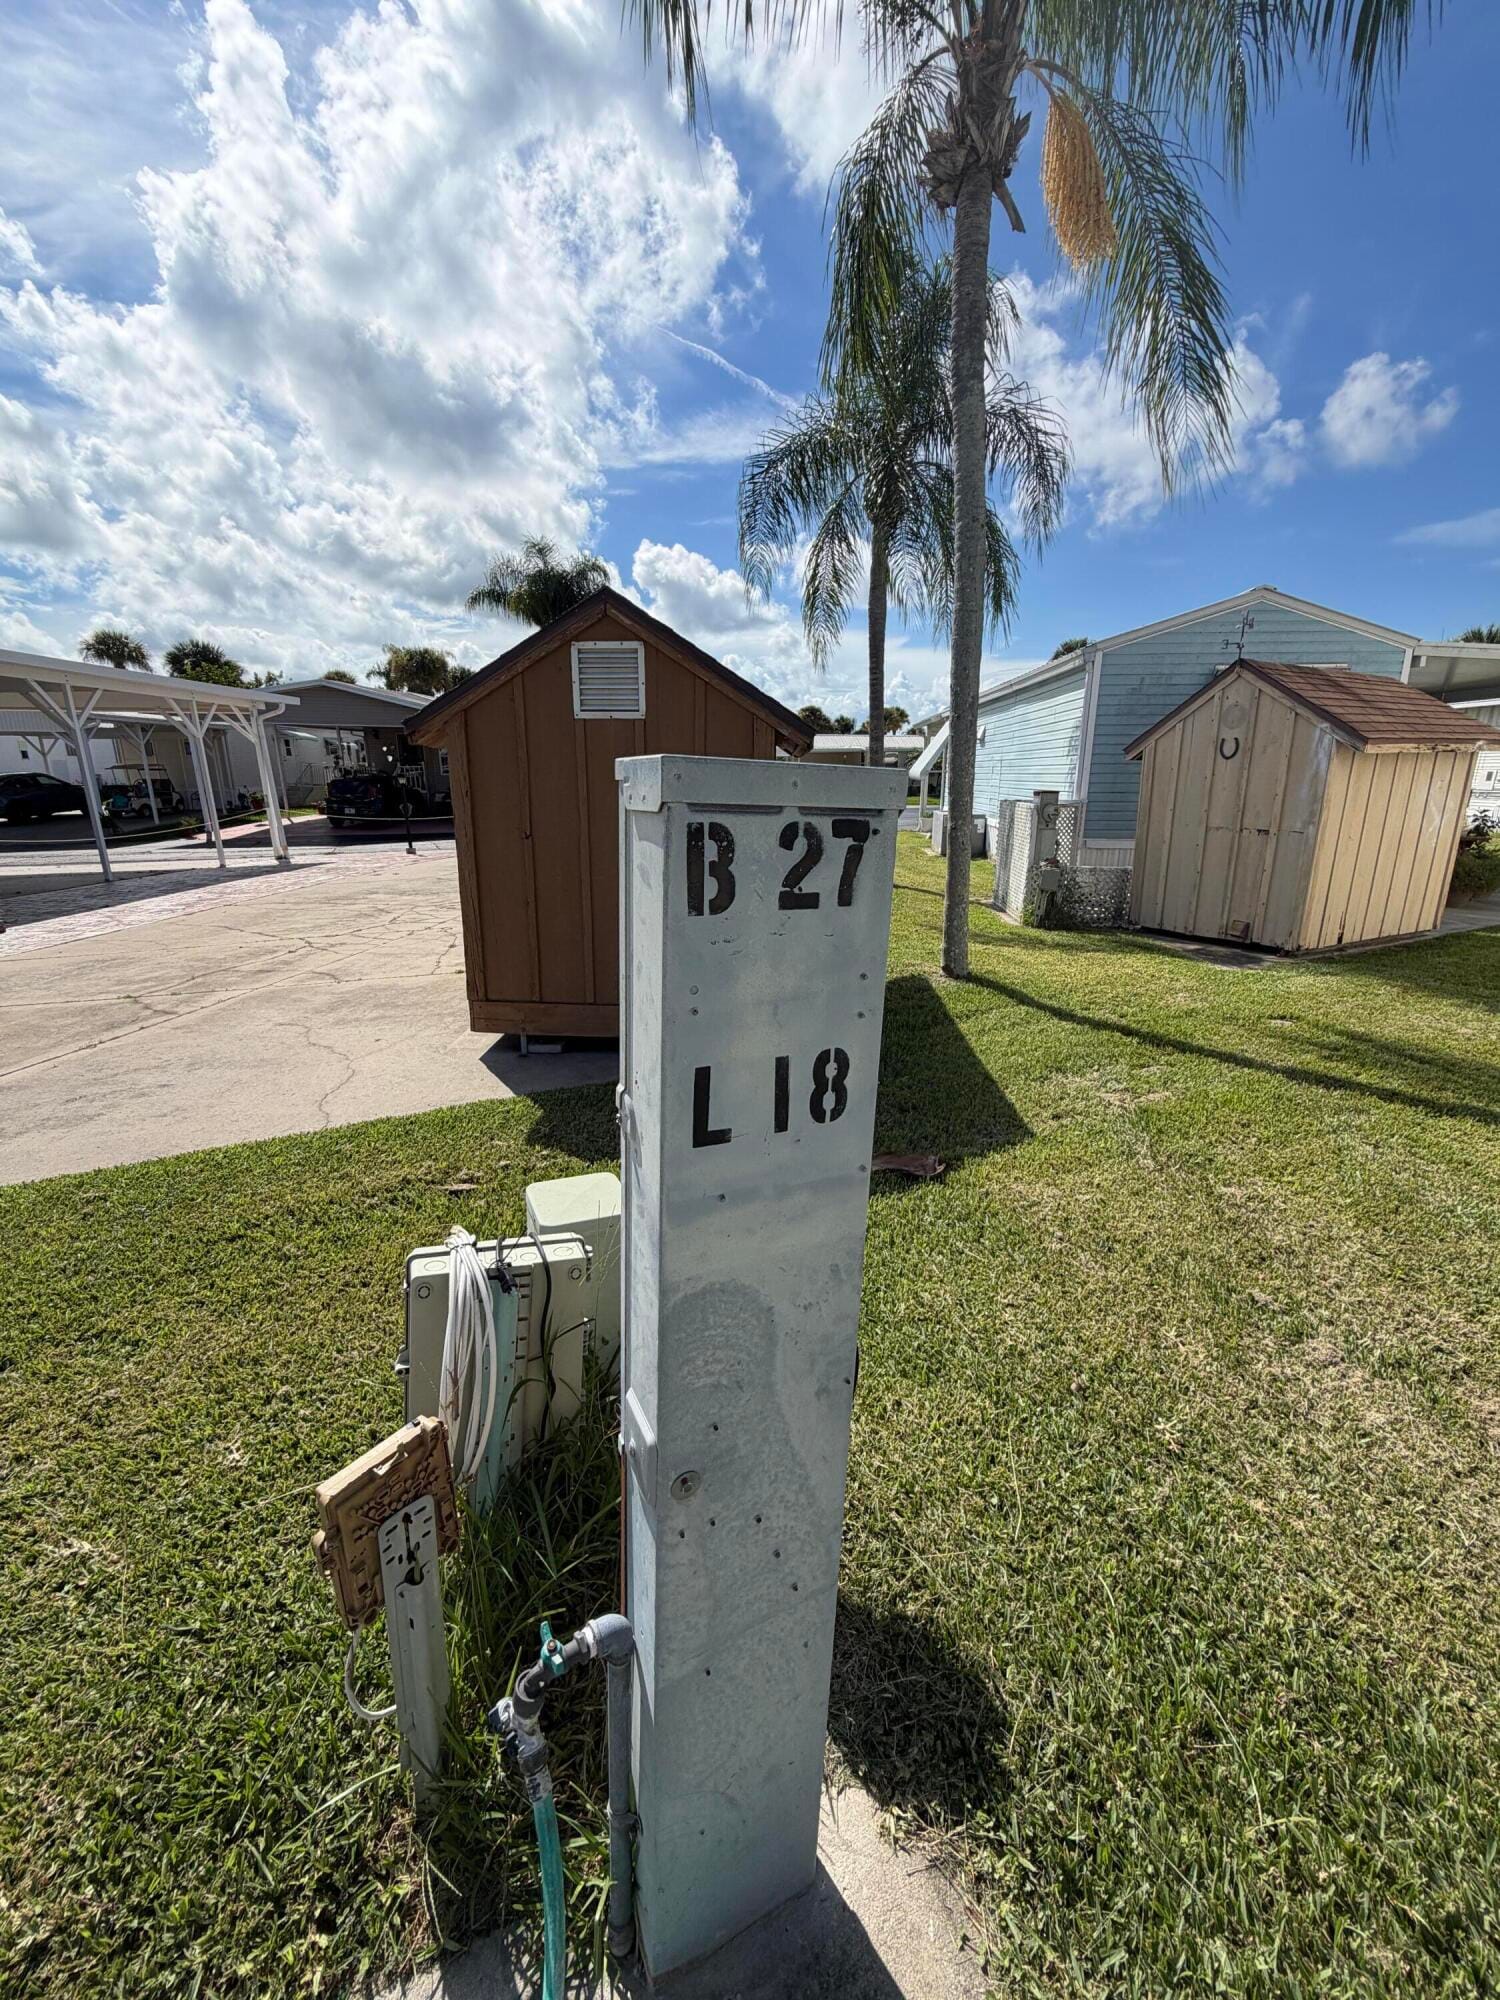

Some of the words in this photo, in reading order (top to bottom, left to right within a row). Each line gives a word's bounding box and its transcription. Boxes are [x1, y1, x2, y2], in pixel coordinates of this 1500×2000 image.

[686, 821, 736, 916] B
[778, 818, 871, 911] 27
[692, 1065, 733, 1149] L
[773, 1047, 850, 1134] 18
